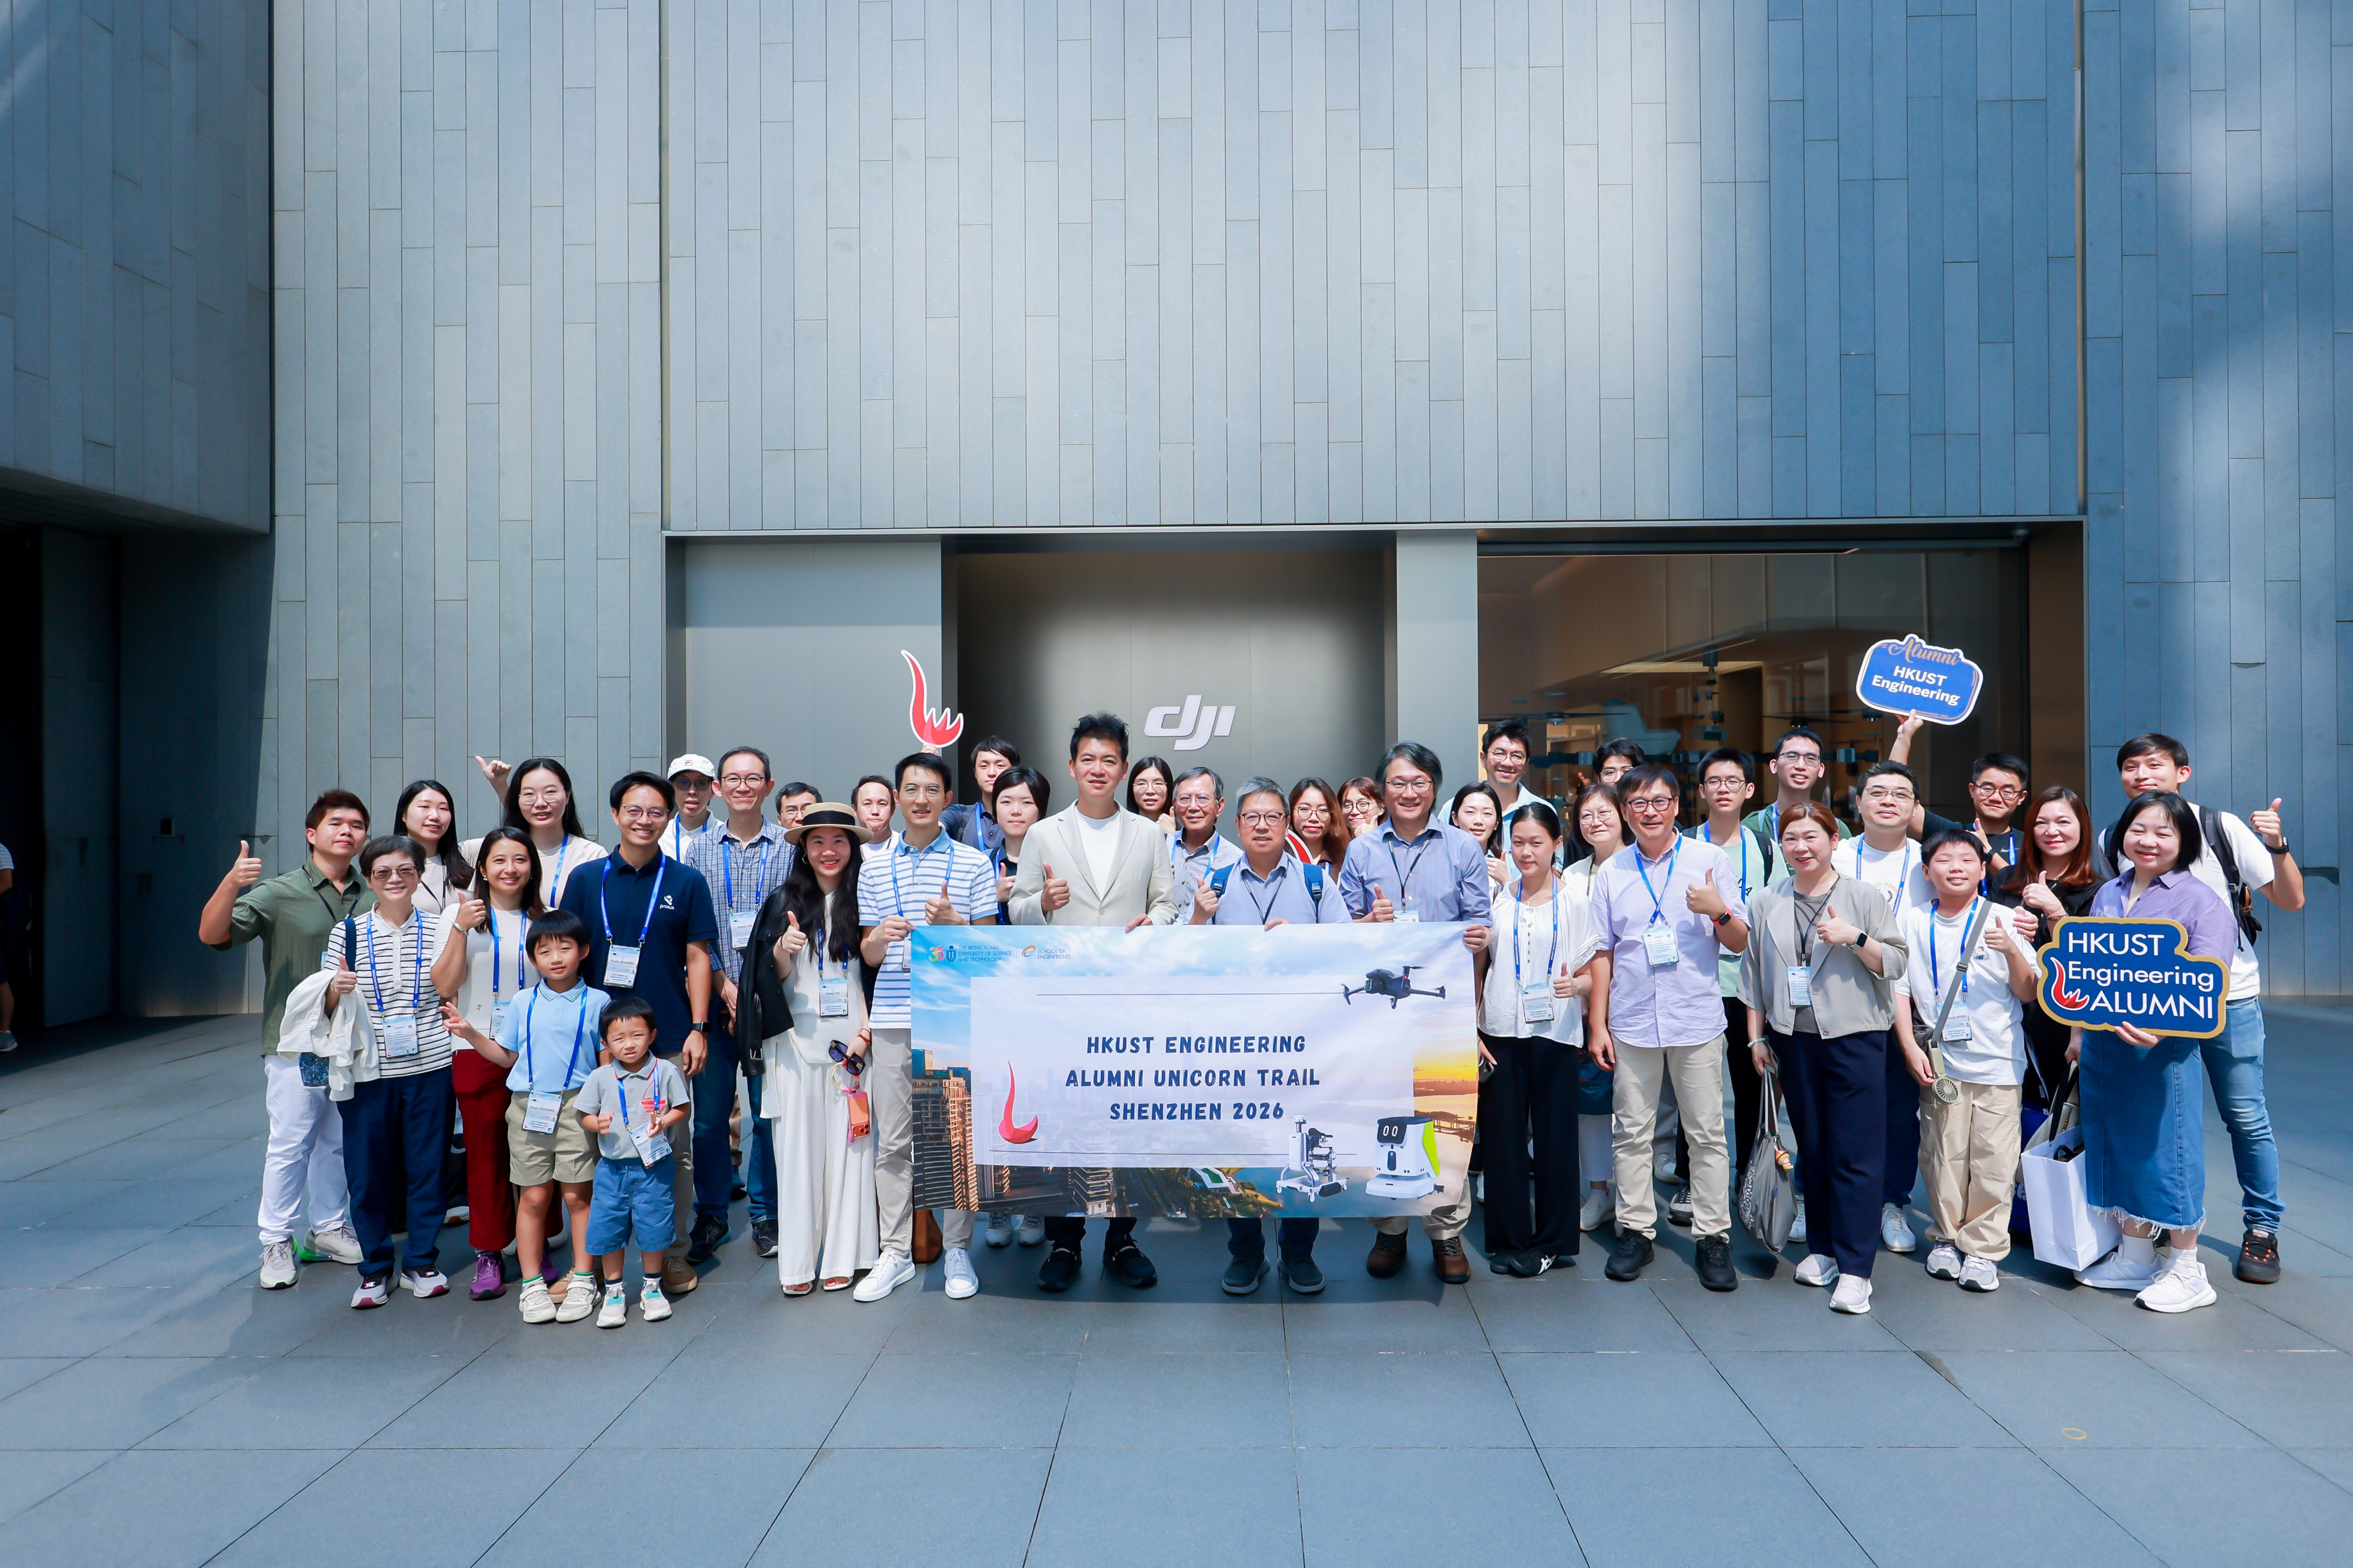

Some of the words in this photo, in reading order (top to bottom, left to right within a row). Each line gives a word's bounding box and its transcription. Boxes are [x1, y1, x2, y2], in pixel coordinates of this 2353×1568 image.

[1888, 638, 1959, 665] Alumni
[1893, 665, 1947, 686] HKUST
[1872, 675, 1961, 706] Engineering
[2068, 932, 2165, 956] HKUST
[2068, 961, 2214, 992] Engineering
[2089, 990, 2212, 1019] ALUMNI
[1086, 1036, 1155, 1055] HKUST
[1165, 1035, 1306, 1054] ENGINEERING
[1065, 1069, 1144, 1087] ALUMNI
[1154, 1069, 1246, 1087] UNICORN
[1257, 1069, 1320, 1087] TRAIL
[1109, 1103, 1222, 1120] SHENZHEN
[1233, 1102, 1284, 1120] 2026
